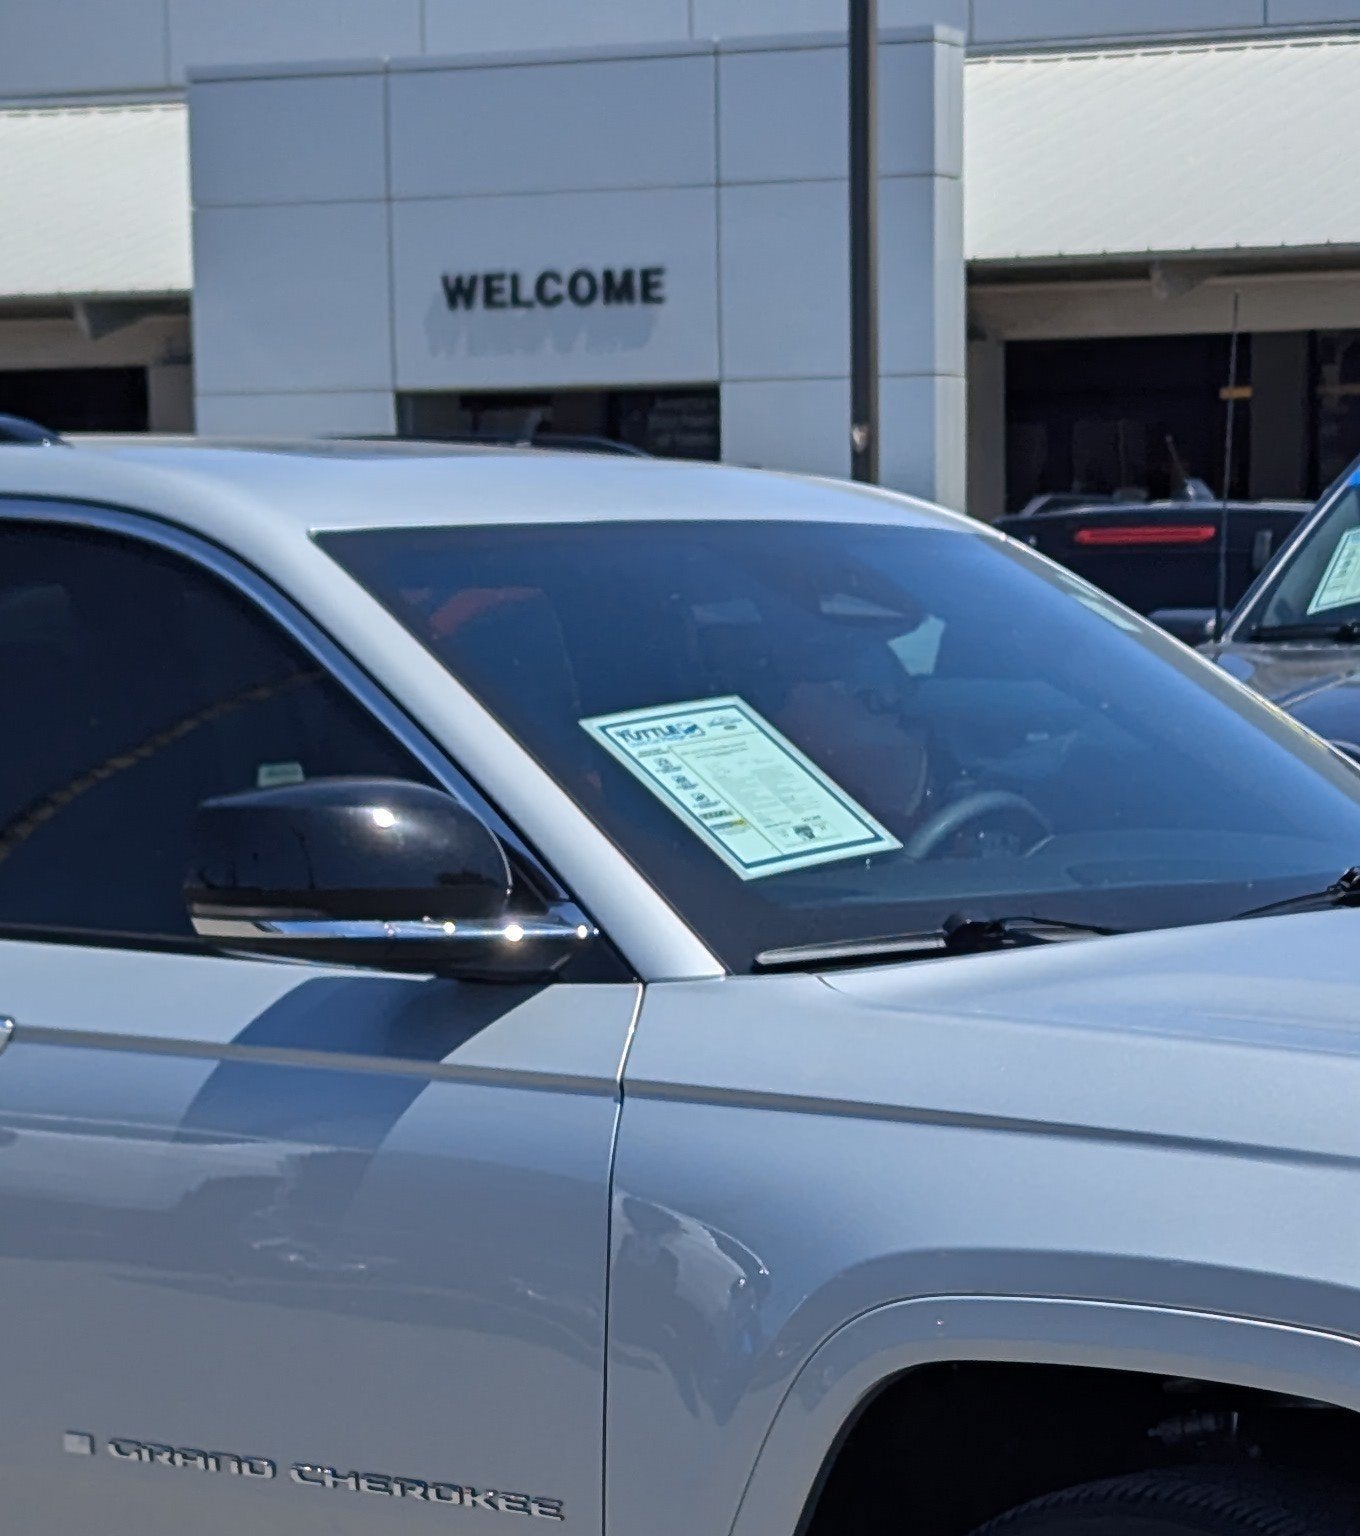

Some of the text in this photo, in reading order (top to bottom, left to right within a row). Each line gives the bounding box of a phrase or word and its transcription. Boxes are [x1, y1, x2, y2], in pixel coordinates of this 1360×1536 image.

[441, 267, 666, 311] WELCOME
[107, 1437, 566, 1522] GRAND CHEROKEE
